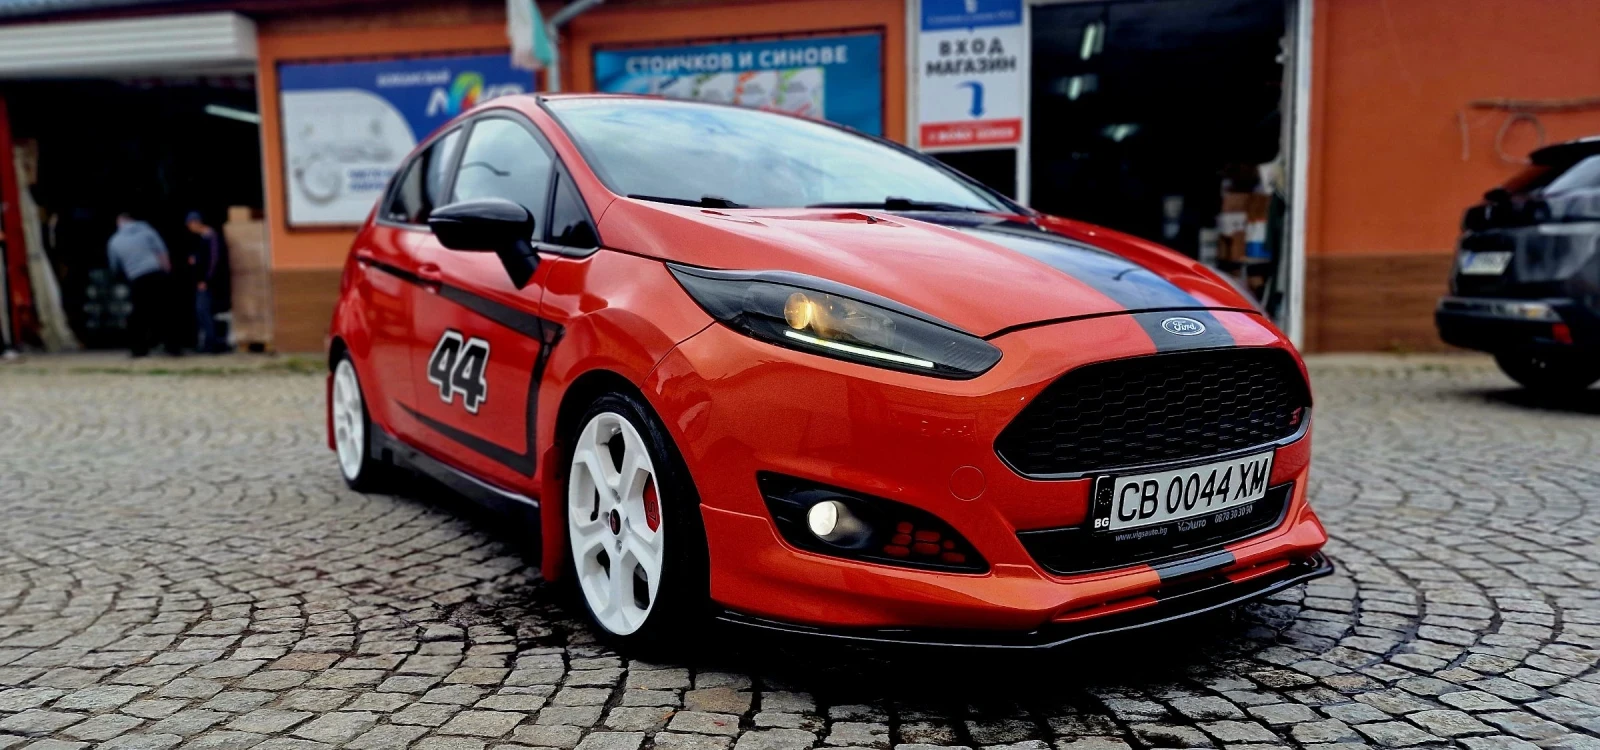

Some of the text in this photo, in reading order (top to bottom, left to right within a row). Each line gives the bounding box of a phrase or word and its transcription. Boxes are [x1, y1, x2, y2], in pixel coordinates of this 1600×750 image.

[739, 50, 753, 68] И
[759, 45, 848, 67] СИНОВЕ
[939, 37, 1004, 56] ВХОД
[926, 56, 1016, 76] МАГАЗИН
[1172, 320, 1197, 332] Ford
[427, 330, 489, 413] 44
[1118, 457, 1269, 522] CB 0044 XM
[1094, 517, 1110, 529] BG
[1115, 527, 1168, 542] www.vigsauto.bg
[1215, 511, 1230, 523] 0878
